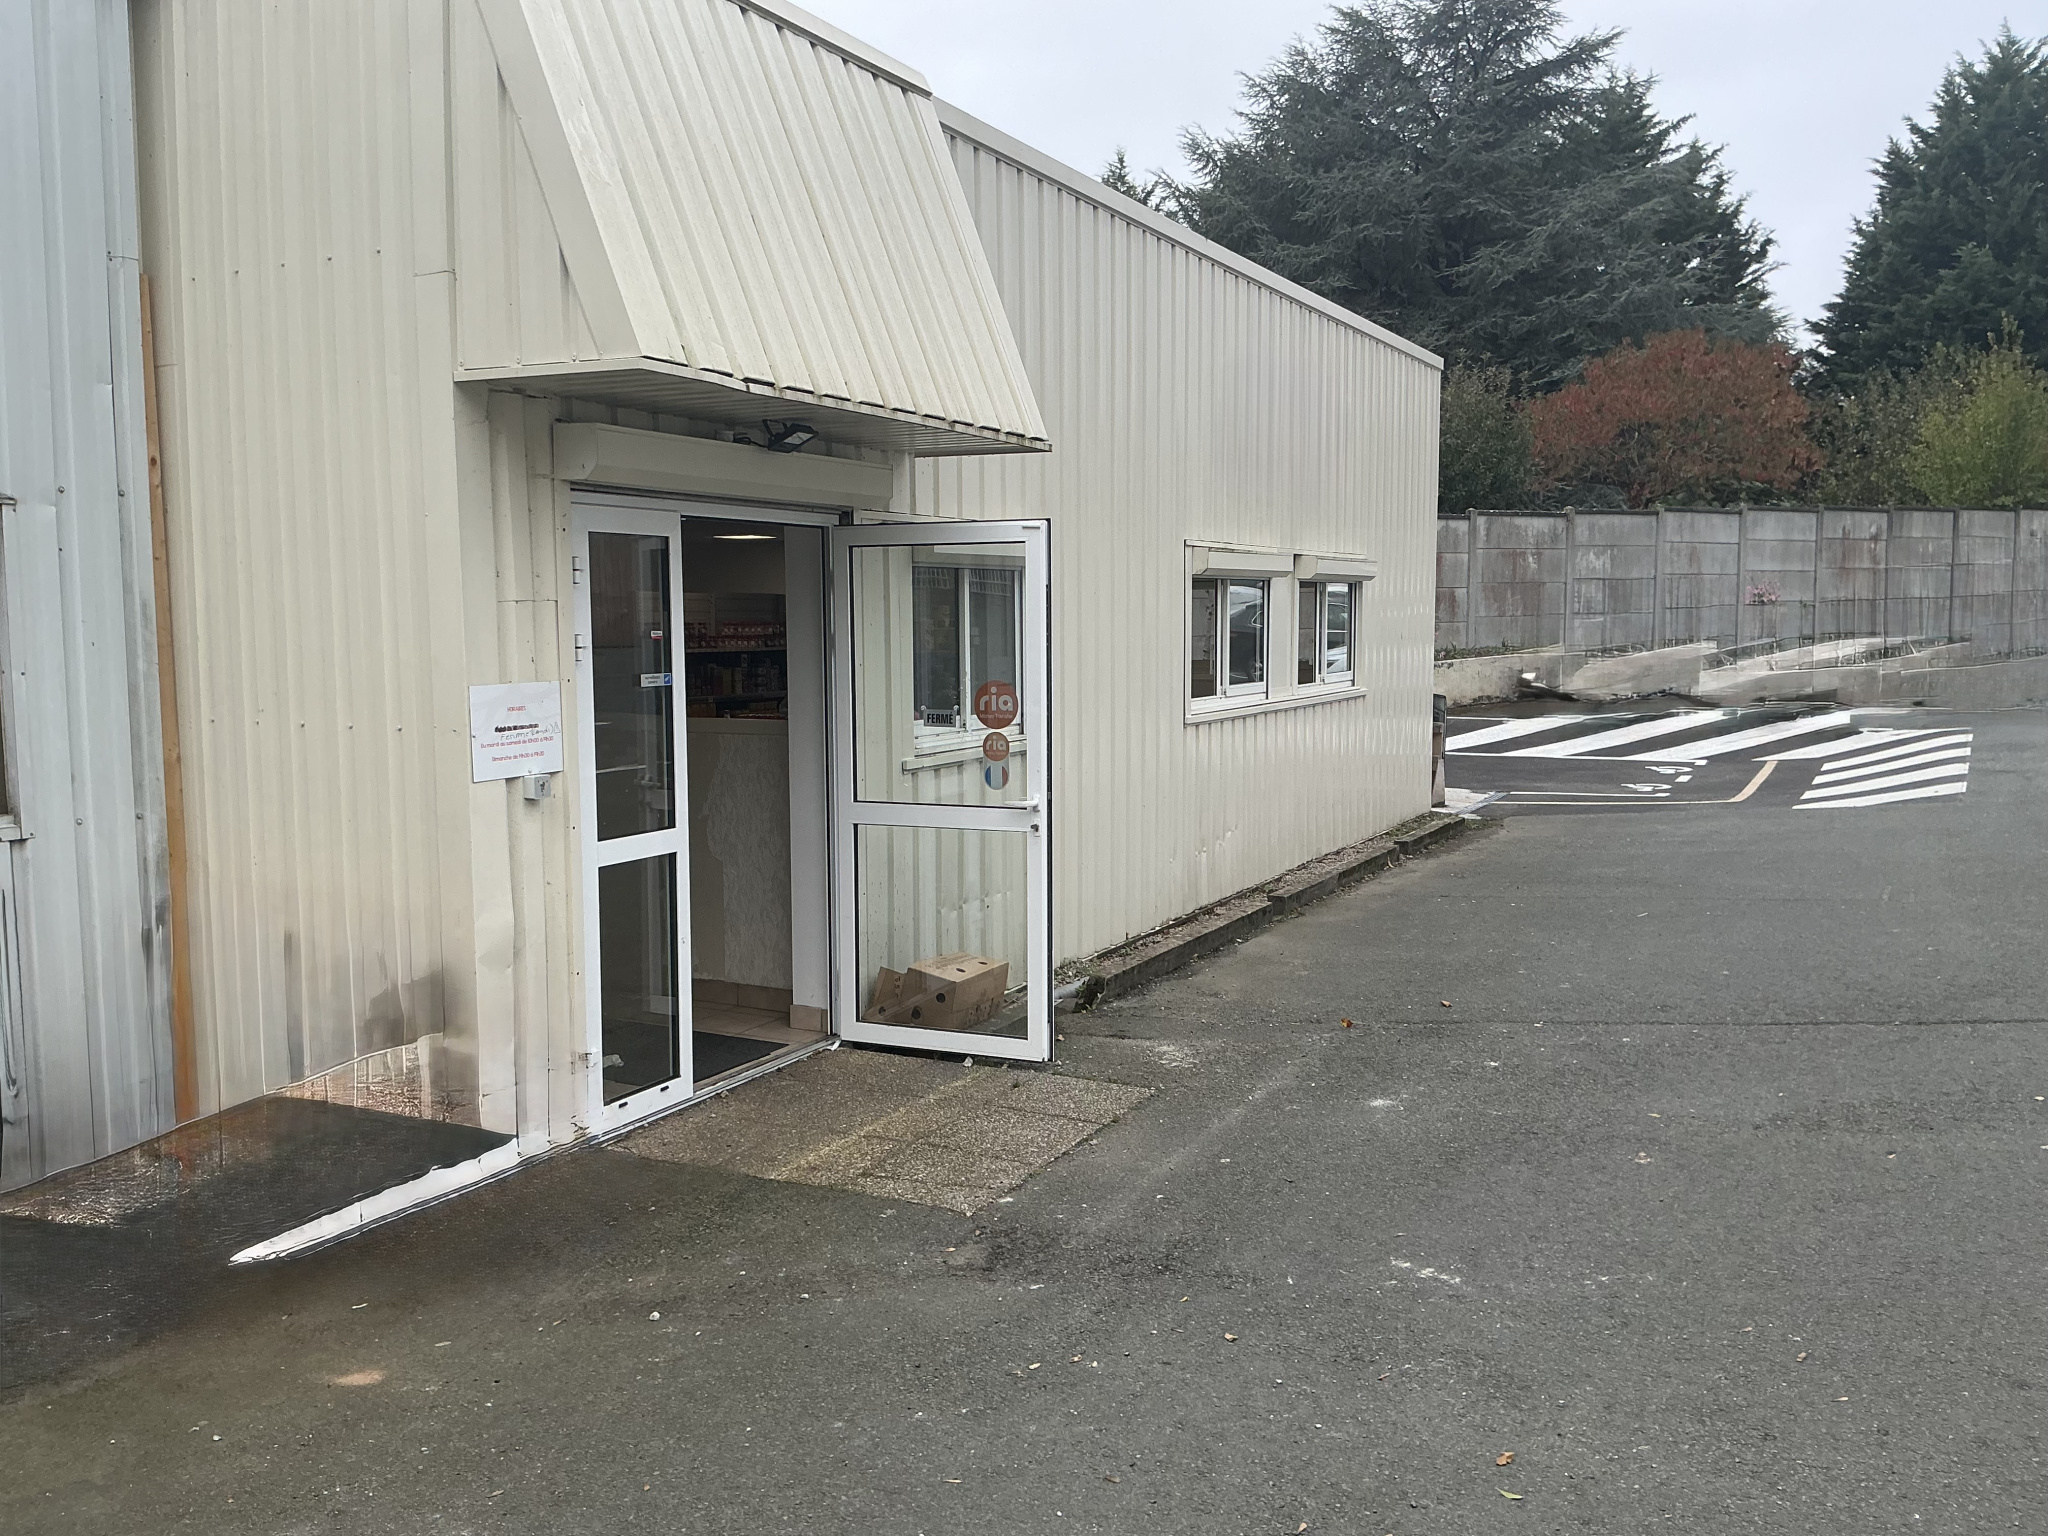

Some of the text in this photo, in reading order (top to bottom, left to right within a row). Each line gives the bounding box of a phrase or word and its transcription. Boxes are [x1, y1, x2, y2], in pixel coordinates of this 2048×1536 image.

[979, 686, 1013, 712] ria
[927, 712, 953, 724] FERMÉ
[985, 735, 1007, 750] ria
